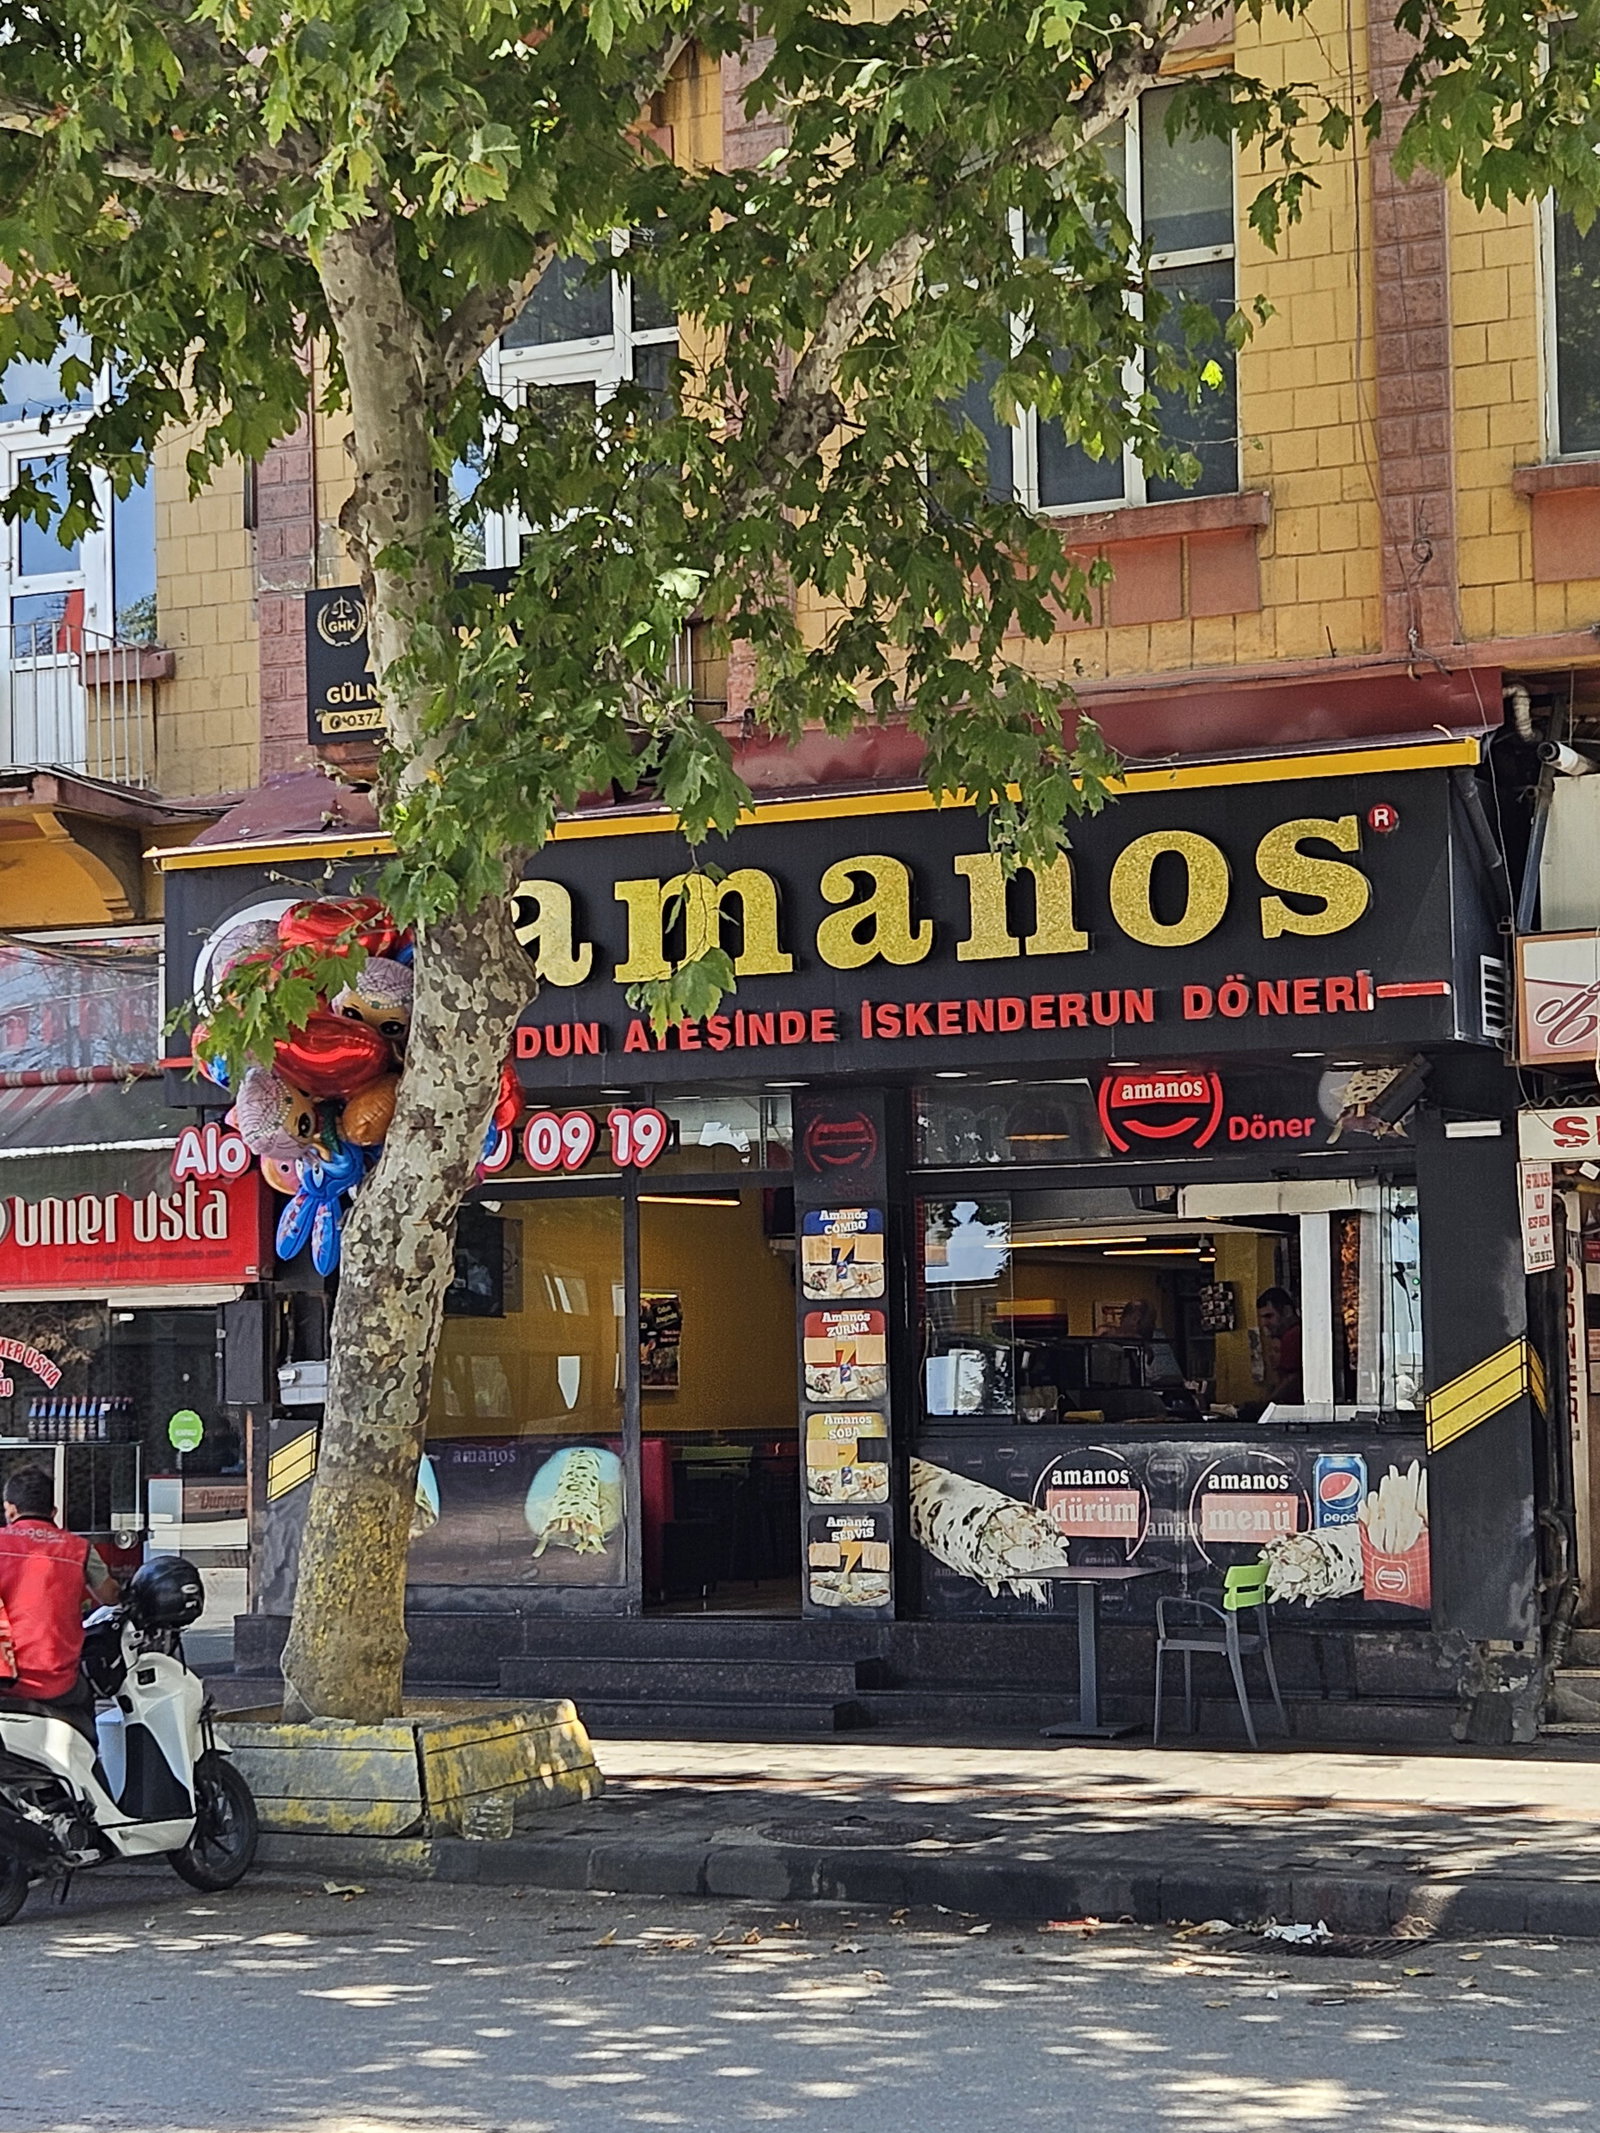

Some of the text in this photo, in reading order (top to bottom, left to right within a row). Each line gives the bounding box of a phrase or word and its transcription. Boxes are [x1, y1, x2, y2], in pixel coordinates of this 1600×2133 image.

[328, 618, 357, 633] GHK
[508, 813, 1371, 987] amanos
[515, 1022, 600, 1059] DUN
[860, 986, 1155, 1040] İSKENDERUN
[1183, 969, 1373, 1022] DÖNERİ
[1121, 1079, 1204, 1101] amanos
[1228, 1114, 1316, 1142] Döner
[174, 1126, 247, 1179] Alo
[527, 1115, 593, 1167] 09
[611, 1112, 664, 1164] 19
[132, 1180, 229, 1243] usta
[818, 1210, 869, 1221] Amanos
[824, 1220, 867, 1234] COMBO
[822, 1311, 871, 1323] Amanos
[826, 1322, 870, 1337] ZURNA
[25, 1348, 61, 1387] USTA
[823, 1414, 872, 1425] Amanos
[1051, 1469, 1130, 1486] amanos
[1207, 1473, 1290, 1490] amanos
[1053, 1496, 1138, 1523] dürüm
[1208, 1501, 1292, 1532] menü
[826, 1516, 876, 1528] Amanos
